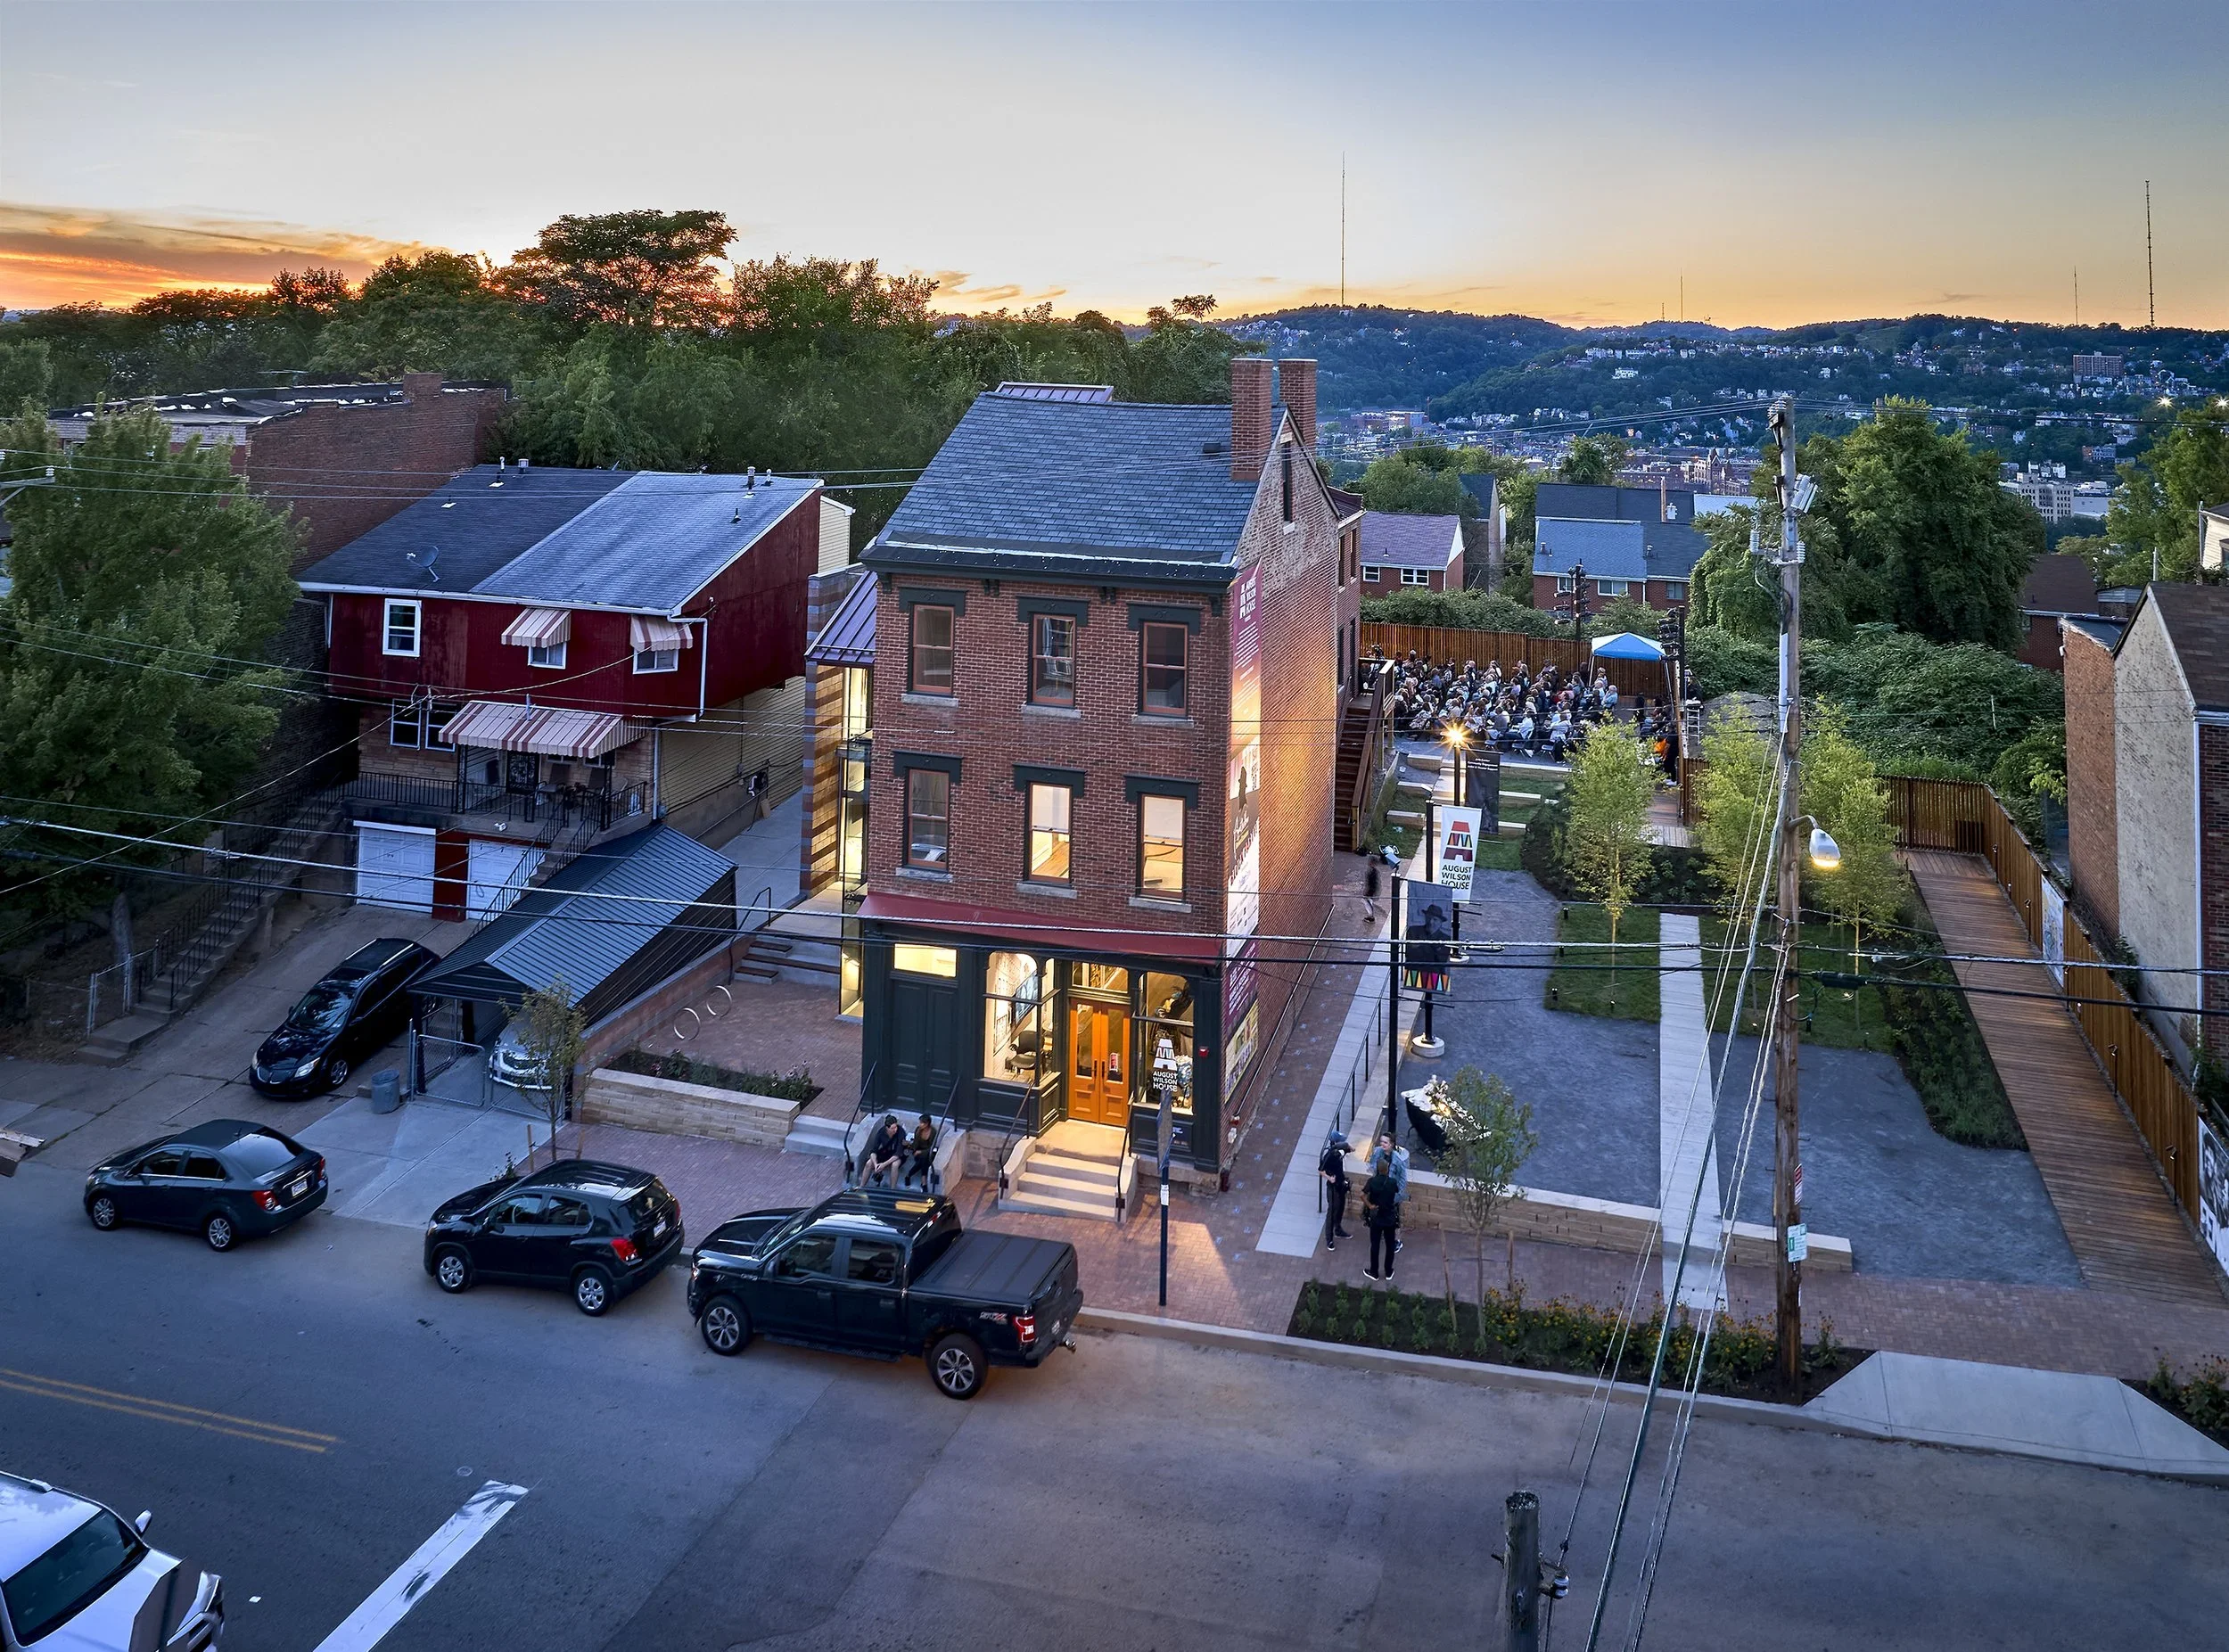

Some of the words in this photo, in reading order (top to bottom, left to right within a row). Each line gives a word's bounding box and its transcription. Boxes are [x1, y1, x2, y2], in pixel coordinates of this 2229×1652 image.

[1442, 864, 1473, 874] AUGUST
[1442, 872, 1471, 881] WILSON
[1153, 1071, 1179, 1080] AUGUST
[1153, 1077, 1178, 1085] WILSON
[1153, 1082, 1178, 1092] HOUSE
